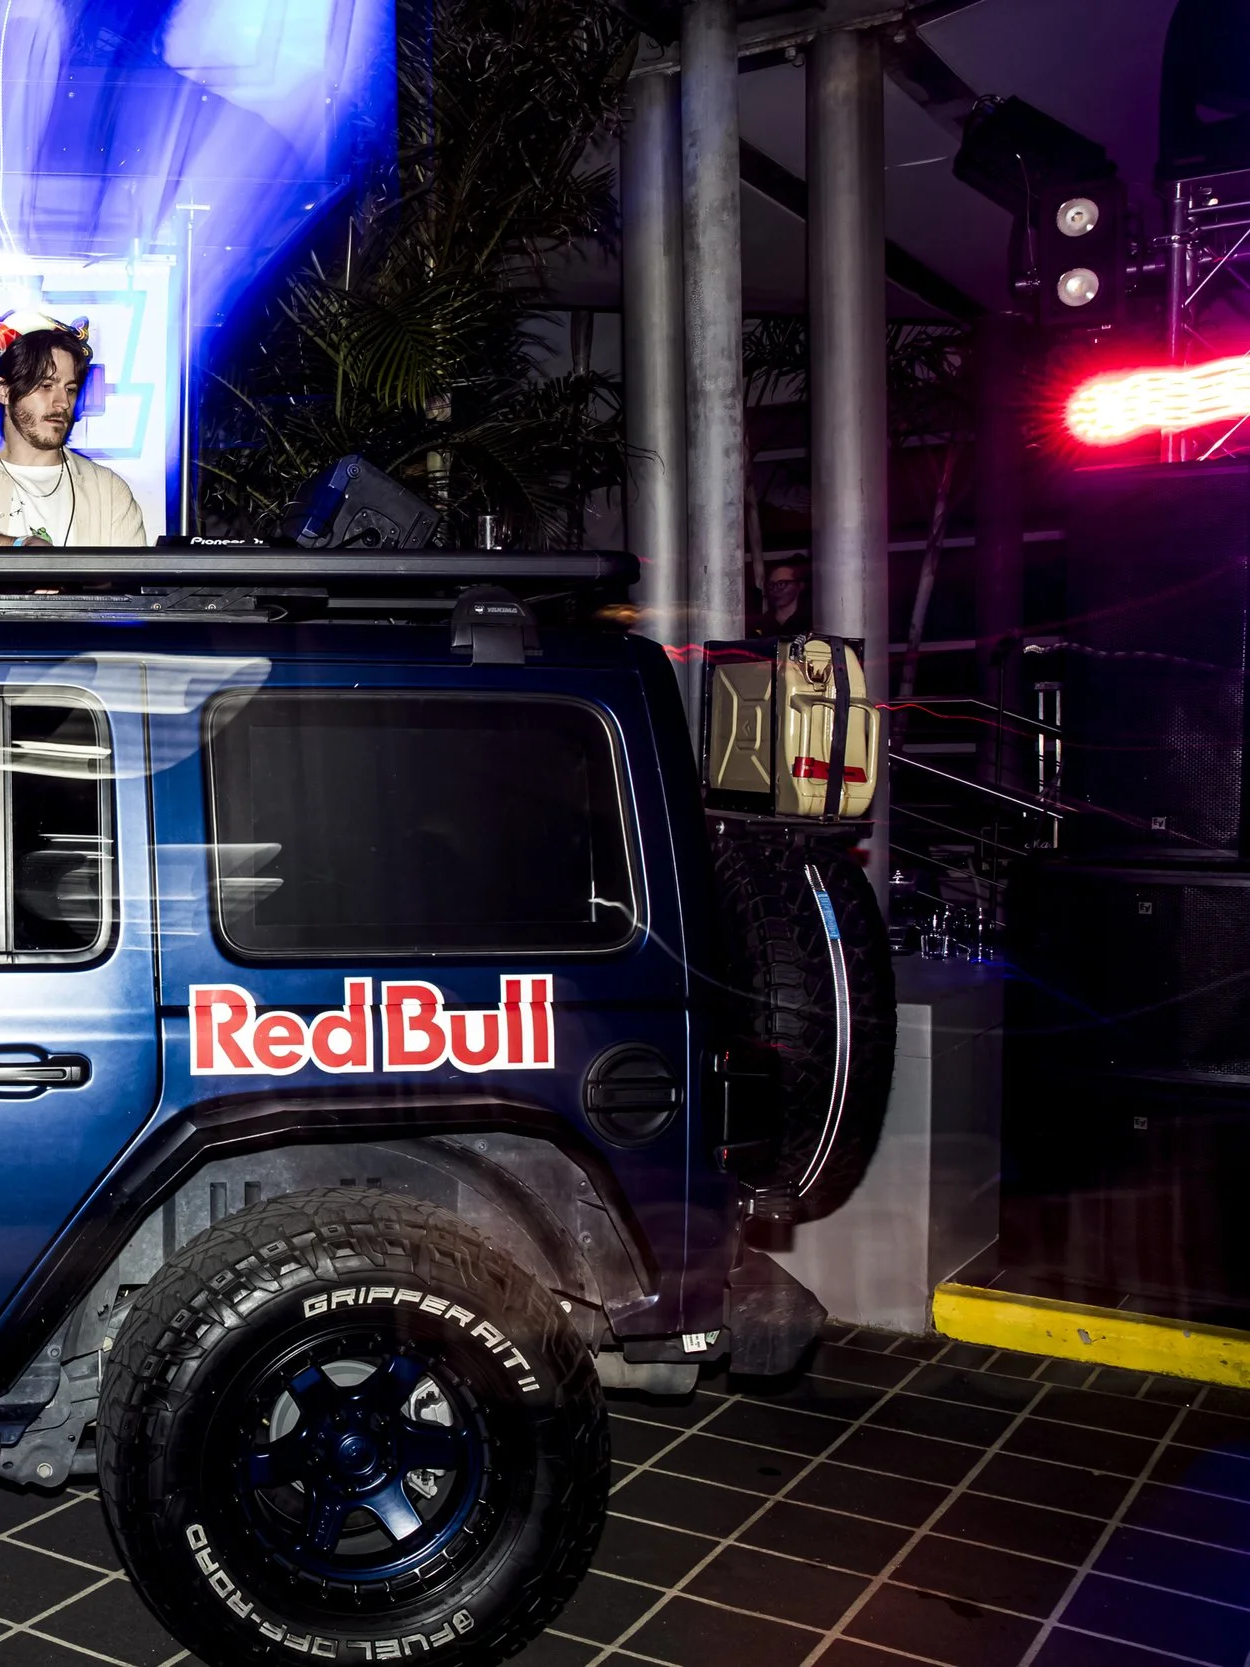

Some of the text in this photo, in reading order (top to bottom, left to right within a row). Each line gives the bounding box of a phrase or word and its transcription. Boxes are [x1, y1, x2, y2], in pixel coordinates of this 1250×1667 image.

[190, 536, 245, 545] Pioneer
[190, 975, 553, 1074] Red Bull
[303, 1286, 476, 1328] GRIPPER
[186, 1523, 456, 1660] FUEL OFF-ROAD
